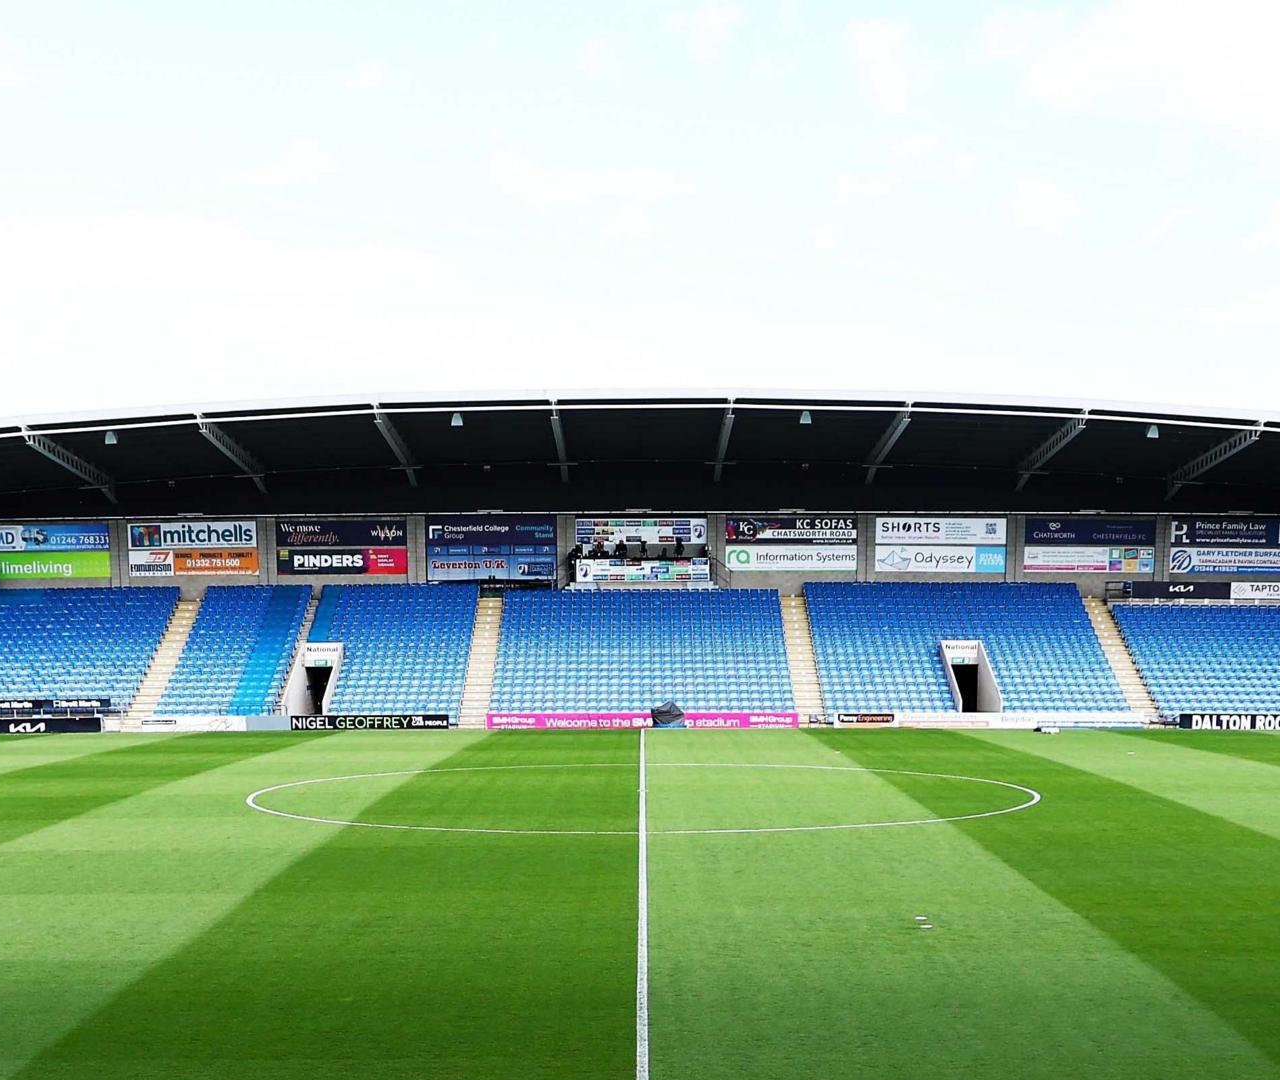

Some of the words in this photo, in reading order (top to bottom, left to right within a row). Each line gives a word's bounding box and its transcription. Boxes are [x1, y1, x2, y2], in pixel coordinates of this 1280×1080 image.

[280, 523, 295, 532] We
[484, 525, 509, 534] College
[515, 525, 553, 533] Community
[796, 520, 811, 529] KC
[815, 520, 853, 529] SOFAS
[1196, 522, 1220, 530] Prince
[1222, 522, 1248, 531] Family
[163, 524, 253, 543] mitchells
[371, 529, 403, 537] WILSON
[50, 536, 77, 544] 01246
[79, 536, 110, 544] 768331
[287, 532, 340, 545] differently.
[293, 554, 363, 567] PINDERS
[756, 552, 814, 561] Information
[816, 552, 856, 563] Systems
[914, 552, 974, 569] Odyssey
[186, 559, 209, 567] 01332
[212, 559, 240, 567] 751500
[432, 560, 481, 570] Leverton
[483, 560, 508, 570] U.K.
[1, 561, 73, 576] limeliving
[292, 716, 333, 729] NIGEL
[336, 716, 409, 729] GEOFFREY
[511, 717, 535, 726] Group
[545, 717, 596, 728] Welcome
[598, 717, 611, 728] to
[612, 717, 631, 728] the
[695, 717, 740, 728] stadium
[769, 716, 793, 725] Group
[1191, 714, 1252, 730] DALTON
